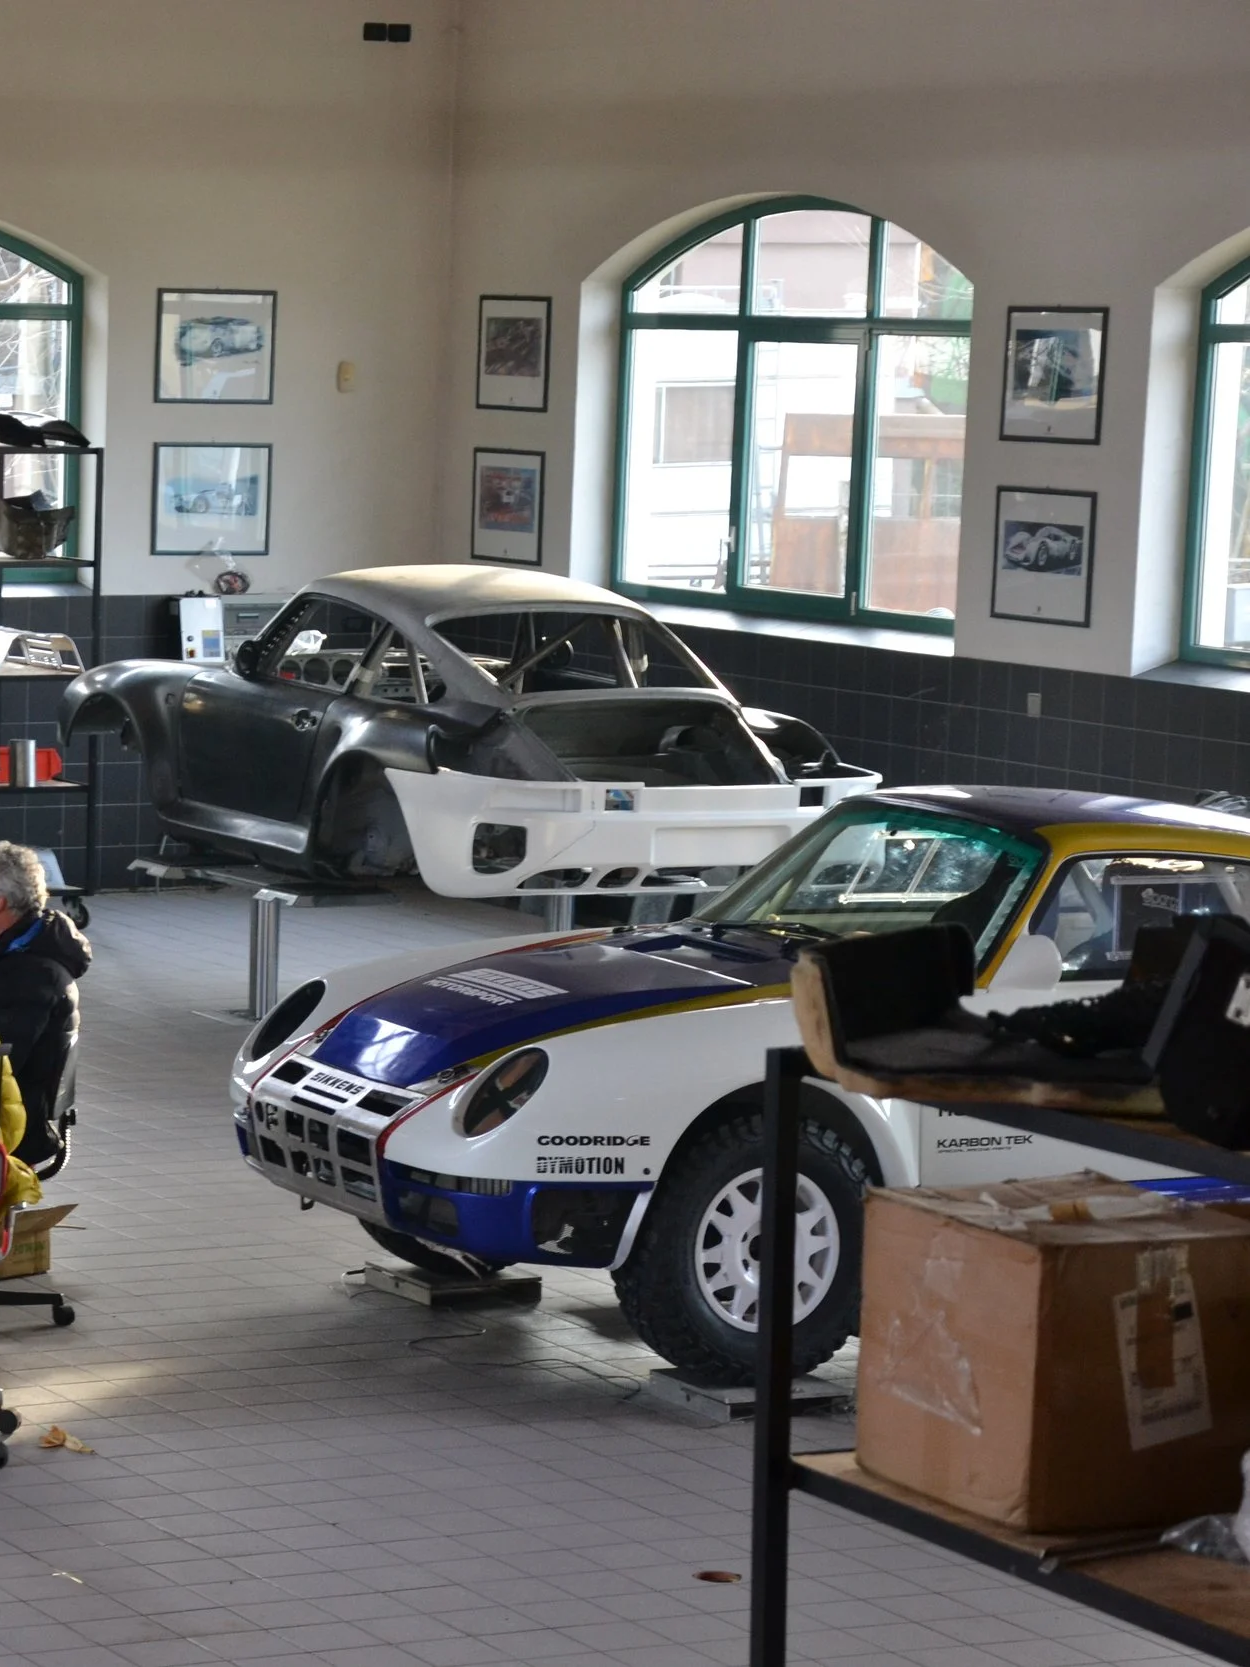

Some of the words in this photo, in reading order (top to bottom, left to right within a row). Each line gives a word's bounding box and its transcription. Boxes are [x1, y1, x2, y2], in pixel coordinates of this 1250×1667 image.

[423, 978, 515, 1006] MOTORSPORT
[310, 1072, 365, 1095] SIKKENS
[537, 1135, 650, 1146] GOODRIDGE
[937, 1137, 1002, 1148] KARBON
[1005, 1135, 1033, 1145] TEK
